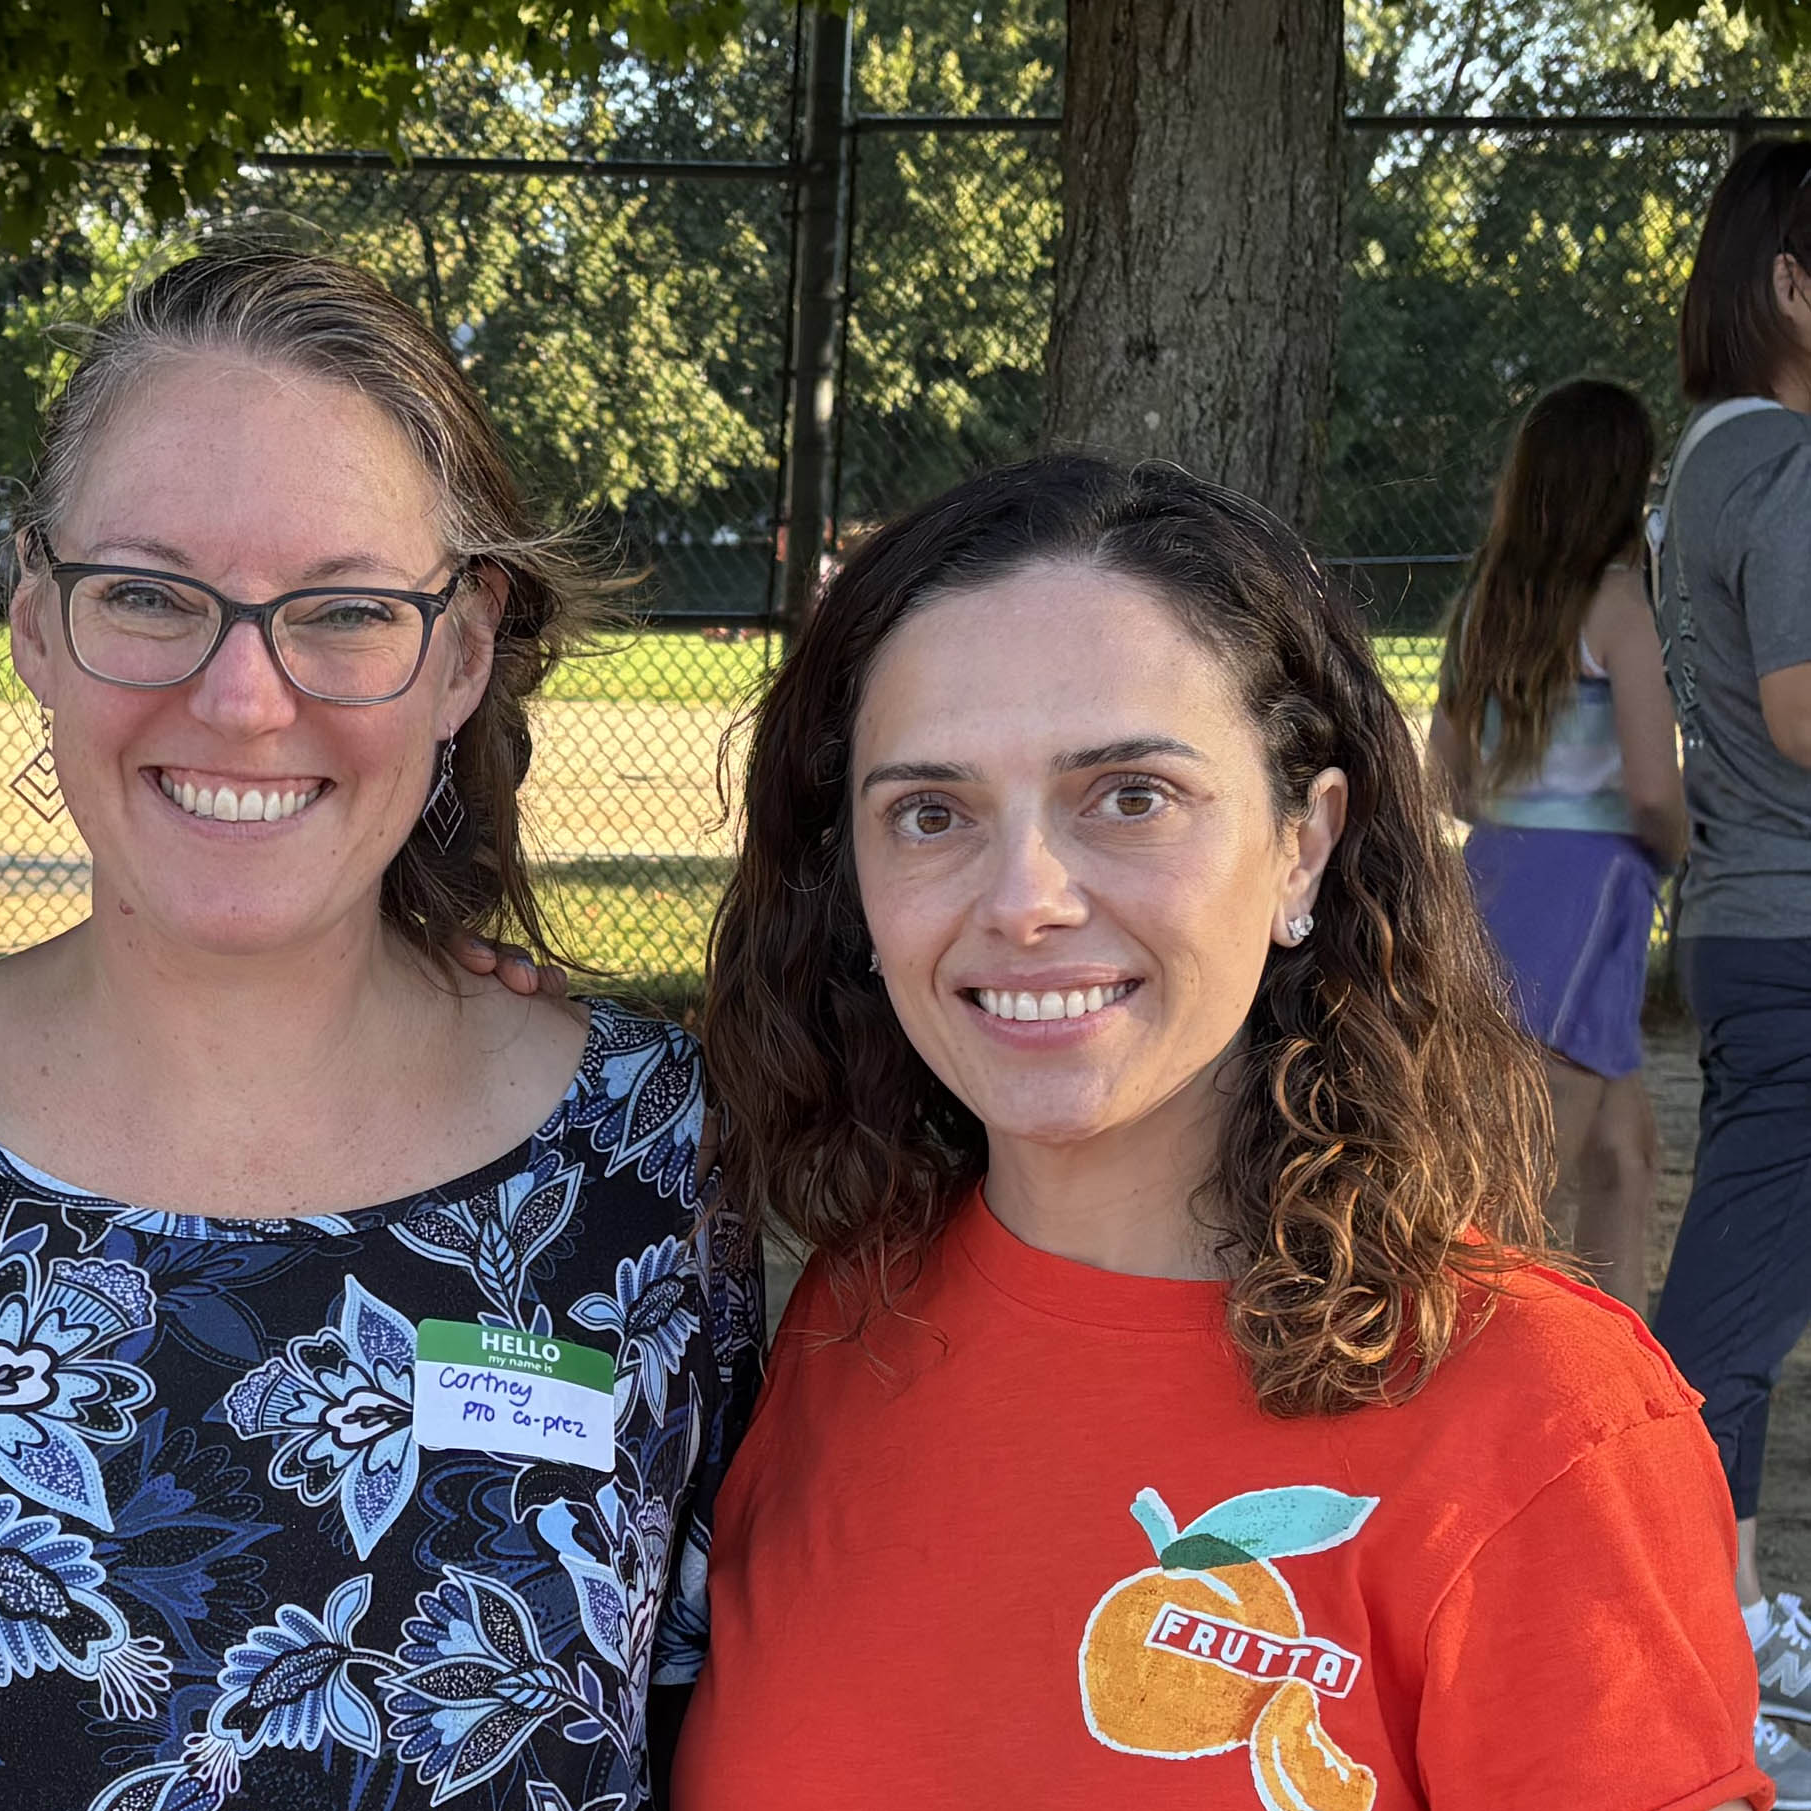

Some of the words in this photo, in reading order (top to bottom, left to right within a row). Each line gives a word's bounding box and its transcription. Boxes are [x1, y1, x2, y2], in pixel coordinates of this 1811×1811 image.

[481, 1331, 561, 1362] HELLO
[488, 1354, 508, 1368] my
[509, 1357, 542, 1373] name
[544, 1361, 553, 1373] is
[439, 1366, 533, 1407] Cortney
[462, 1401, 495, 1422] PTO
[1157, 1611, 1343, 1688] FRUTTA
